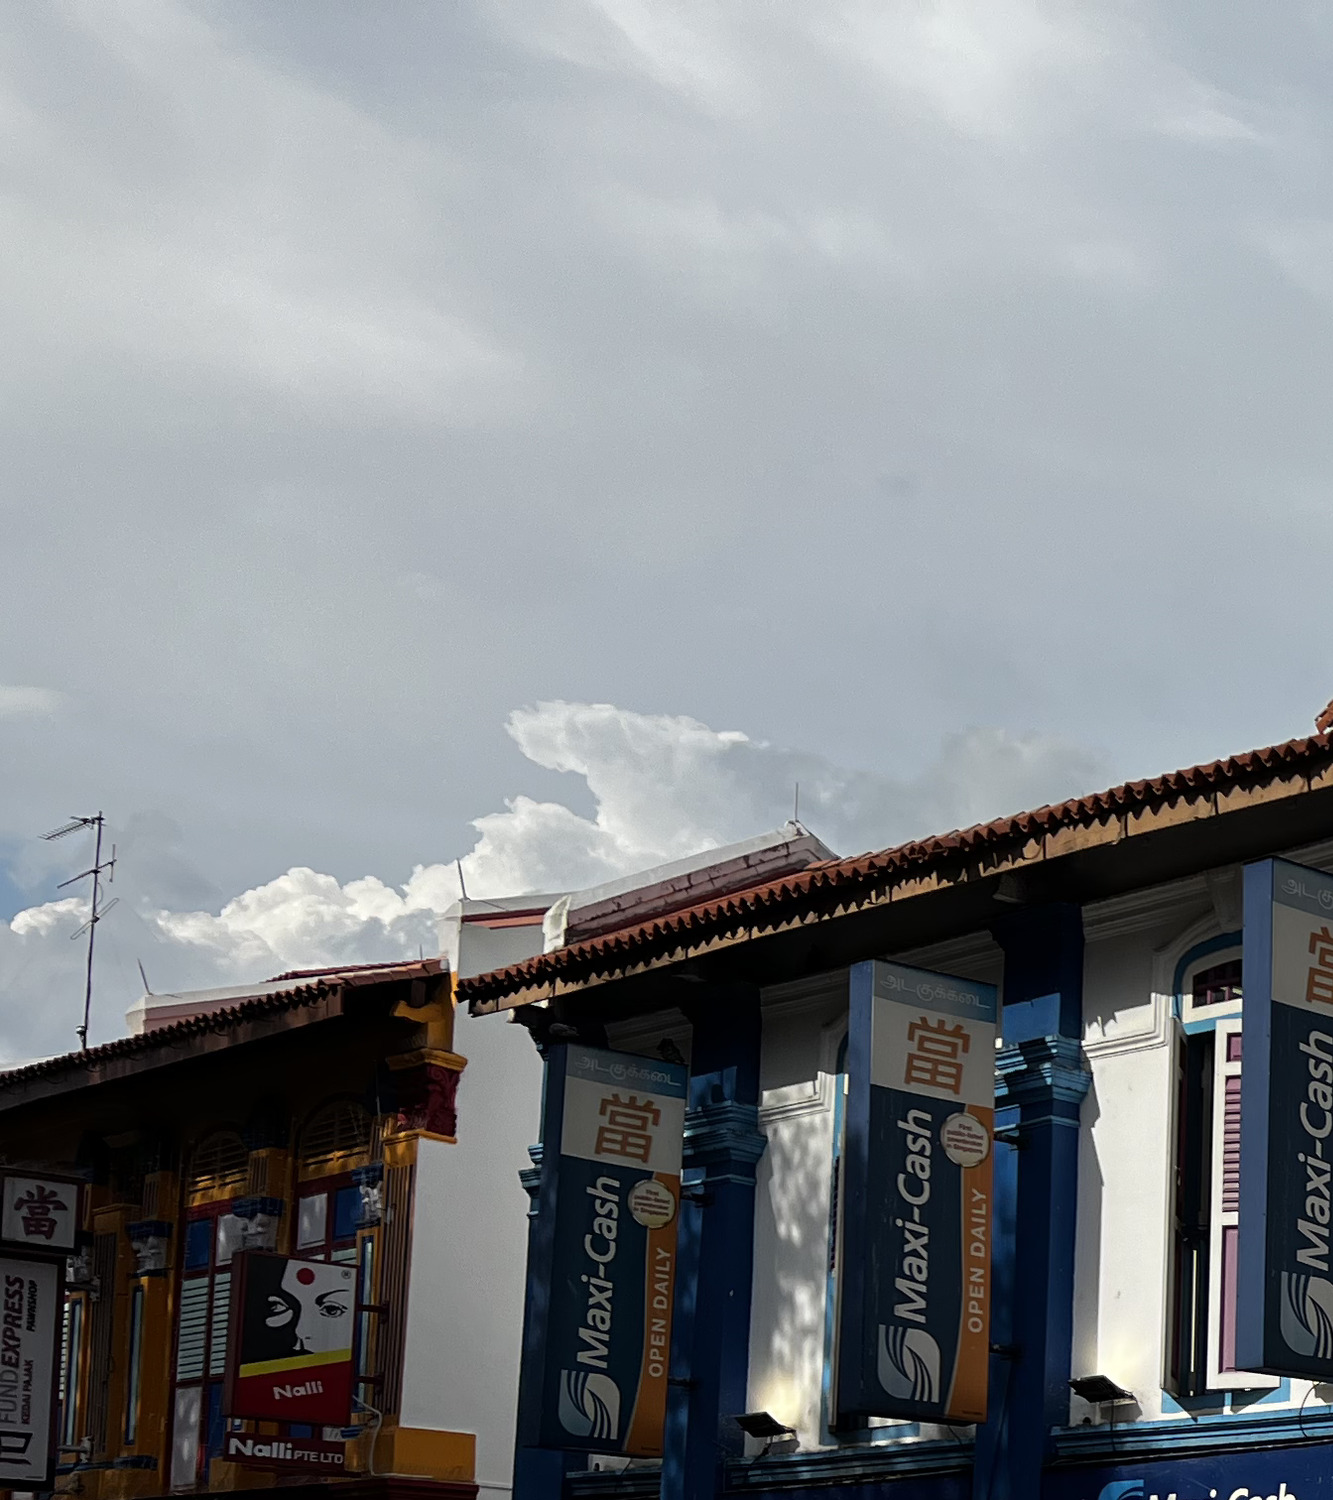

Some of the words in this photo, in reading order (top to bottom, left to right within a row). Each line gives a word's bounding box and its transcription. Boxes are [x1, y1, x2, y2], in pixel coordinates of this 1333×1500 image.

[903, 1016, 971, 1096] 當
[594, 1092, 661, 1164] 當
[13, 1185, 67, 1239] 當
[894, 1107, 933, 1325] Maxi-Cash
[970, 1189, 987, 1253] DAILY
[577, 1175, 621, 1369] Maxi-Cash
[654, 1247, 672, 1311] DAILY
[968, 1268, 984, 1334] OPEN
[648, 1319, 667, 1377] OPEN
[272, 1380, 324, 1400] Nalli
[228, 1438, 293, 1461] Nalli
[293, 1450, 319, 1462] PTE
[320, 1452, 344, 1465] LTD
